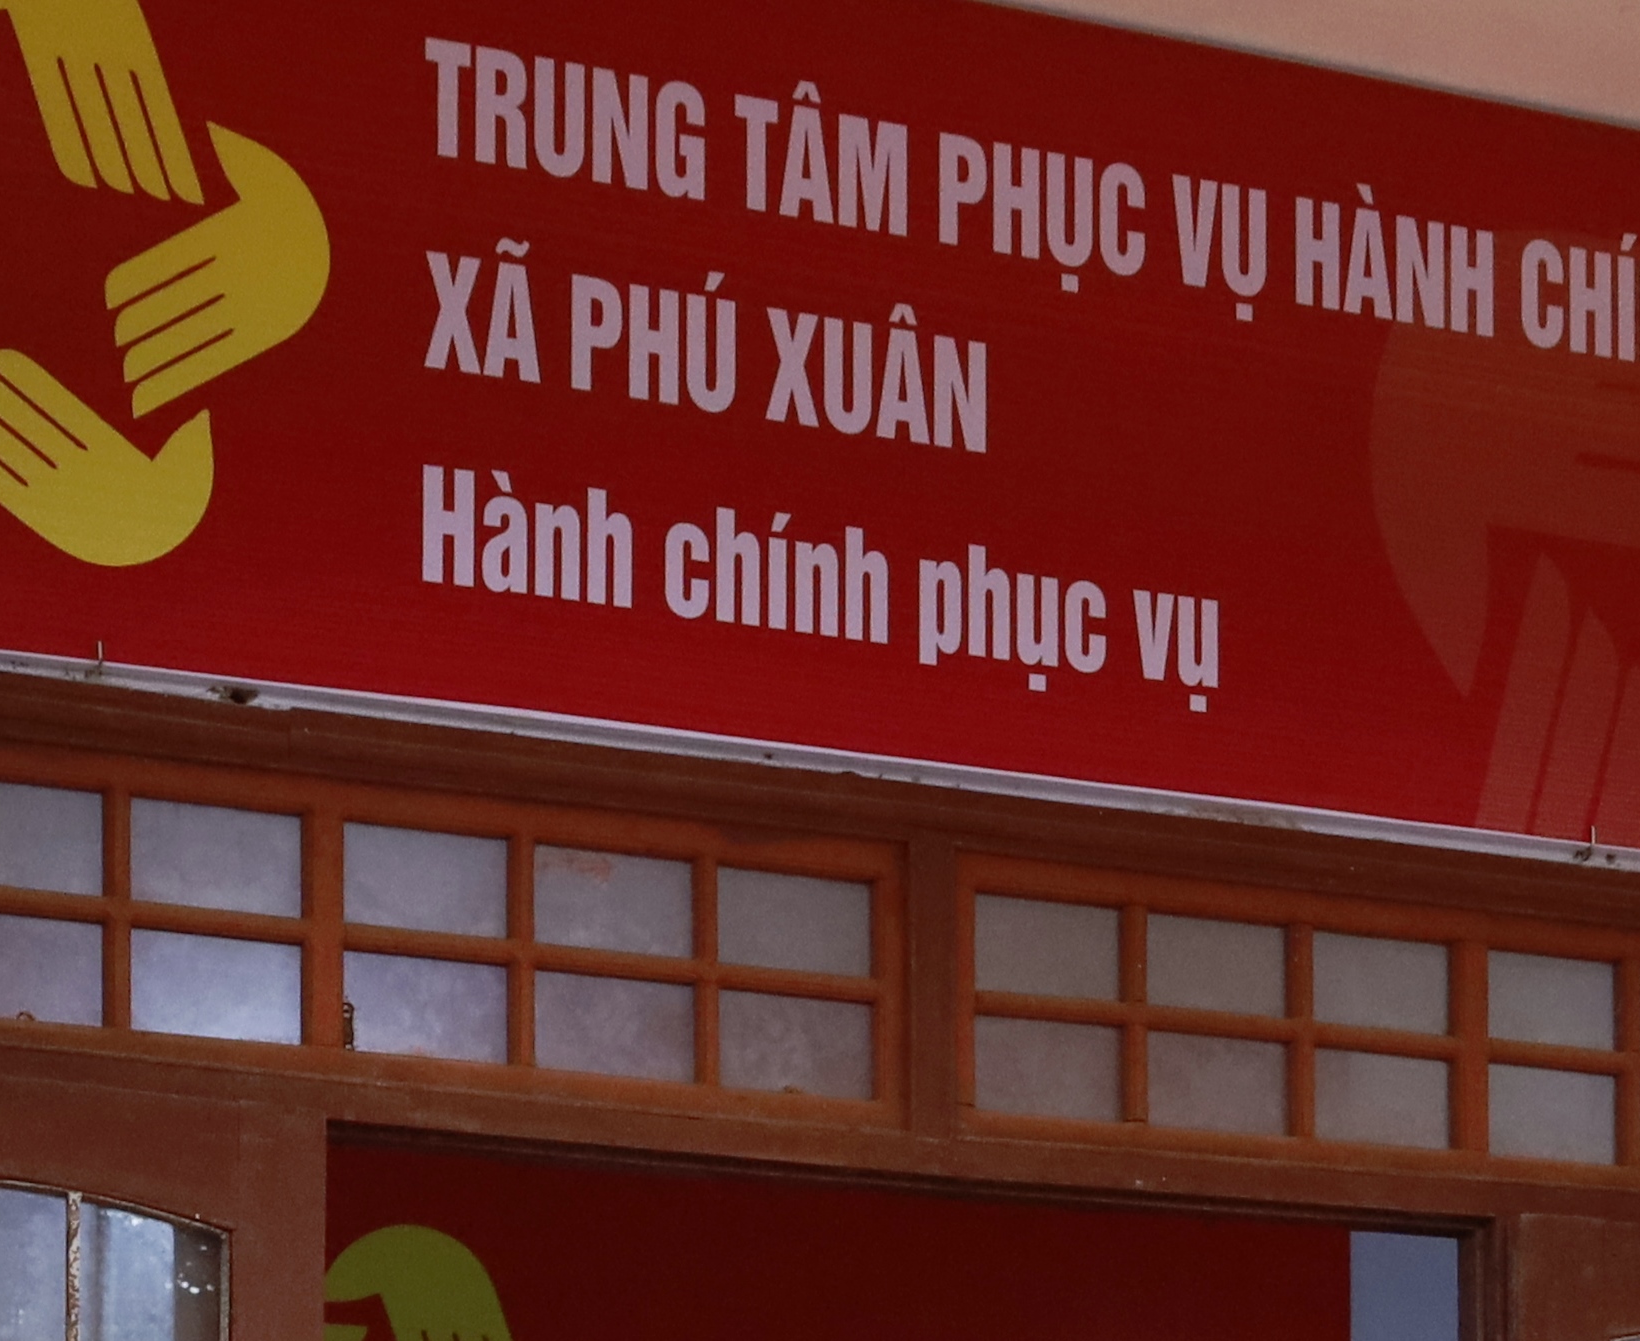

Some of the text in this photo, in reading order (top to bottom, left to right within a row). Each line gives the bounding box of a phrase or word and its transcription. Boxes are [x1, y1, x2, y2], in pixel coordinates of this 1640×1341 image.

[425, 37, 705, 200] TRUNG
[735, 80, 907, 237] TÂM
[939, 132, 1146, 293] PHỤC
[1172, 173, 1267, 322] VỤ
[1296, 183, 1493, 337] HÀNH
[424, 237, 987, 454] XÃ PHÚ XUÂN
[421, 463, 1219, 713] Hành chính phục vụ
